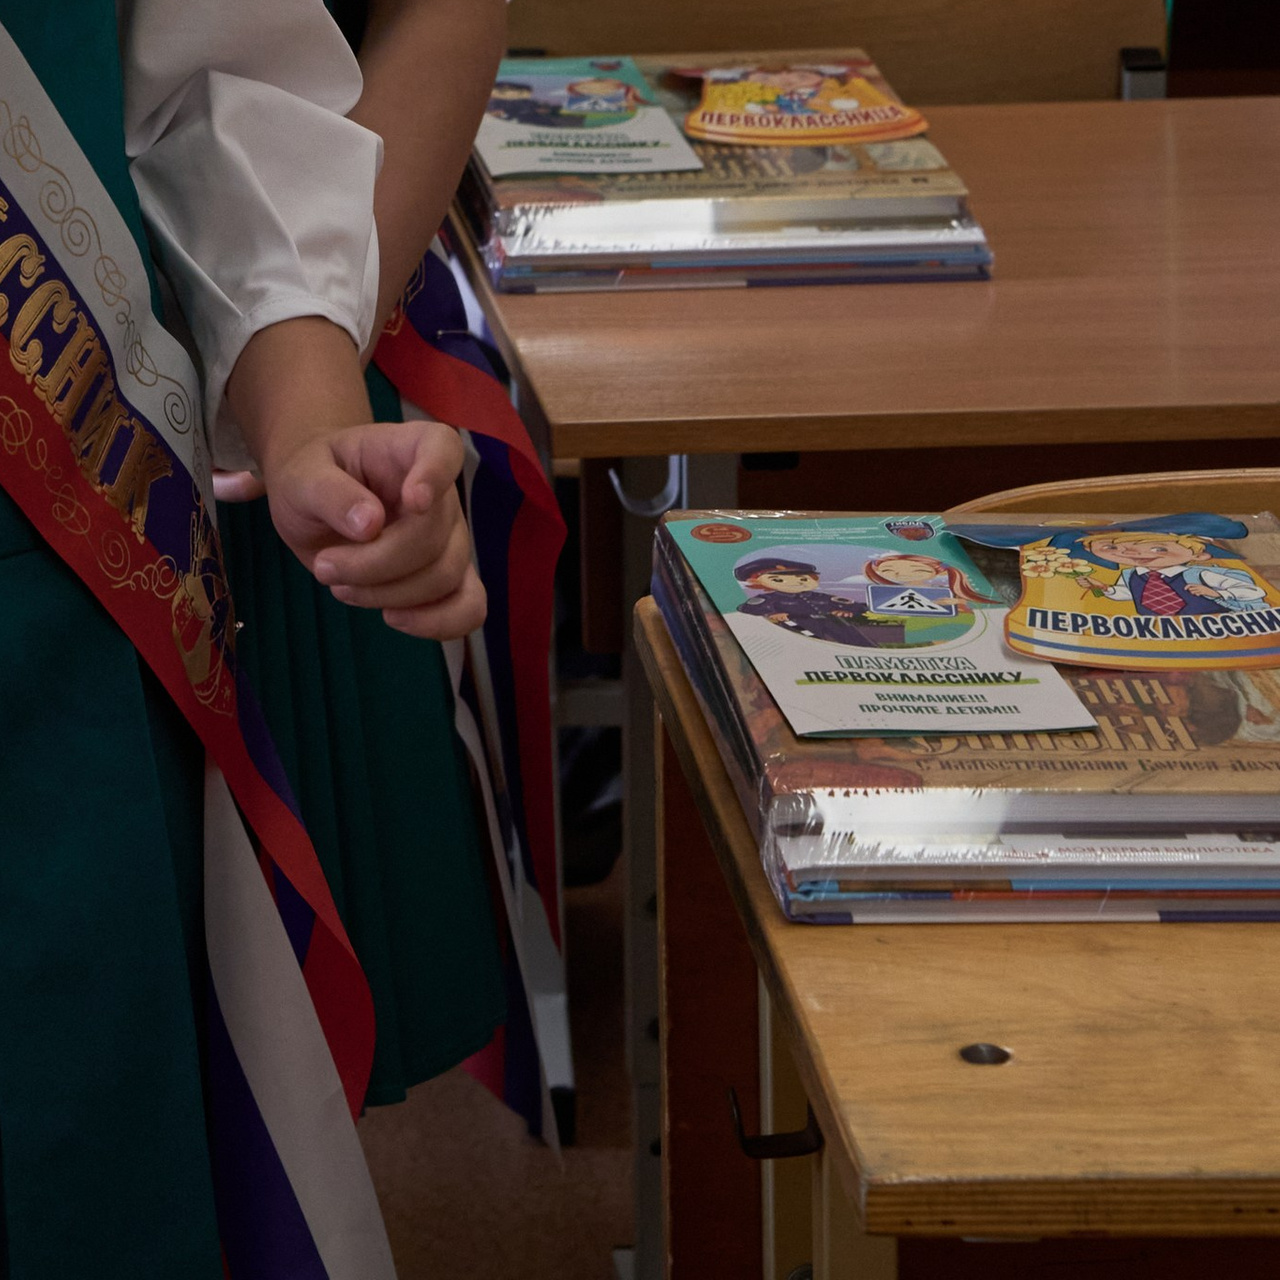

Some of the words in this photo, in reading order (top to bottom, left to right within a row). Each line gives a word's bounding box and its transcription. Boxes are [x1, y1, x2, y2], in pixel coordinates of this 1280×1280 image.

[700, 105, 906, 129] ПЕРВОКЛАССНИЦА
[1027, 607, 1280, 640] ПЕРВОКЛАССНИ
[834, 655, 978, 671] ПАМЯТКА
[803, 671, 1023, 684] ПЕРВОКЛАССНИКУ
[874, 693, 988, 703] ВНИМАНИЕ!!!
[858, 704, 941, 714] ПРОЧТИТЕ
[945, 704, 1022, 715] ДЕТЯМ!!!
